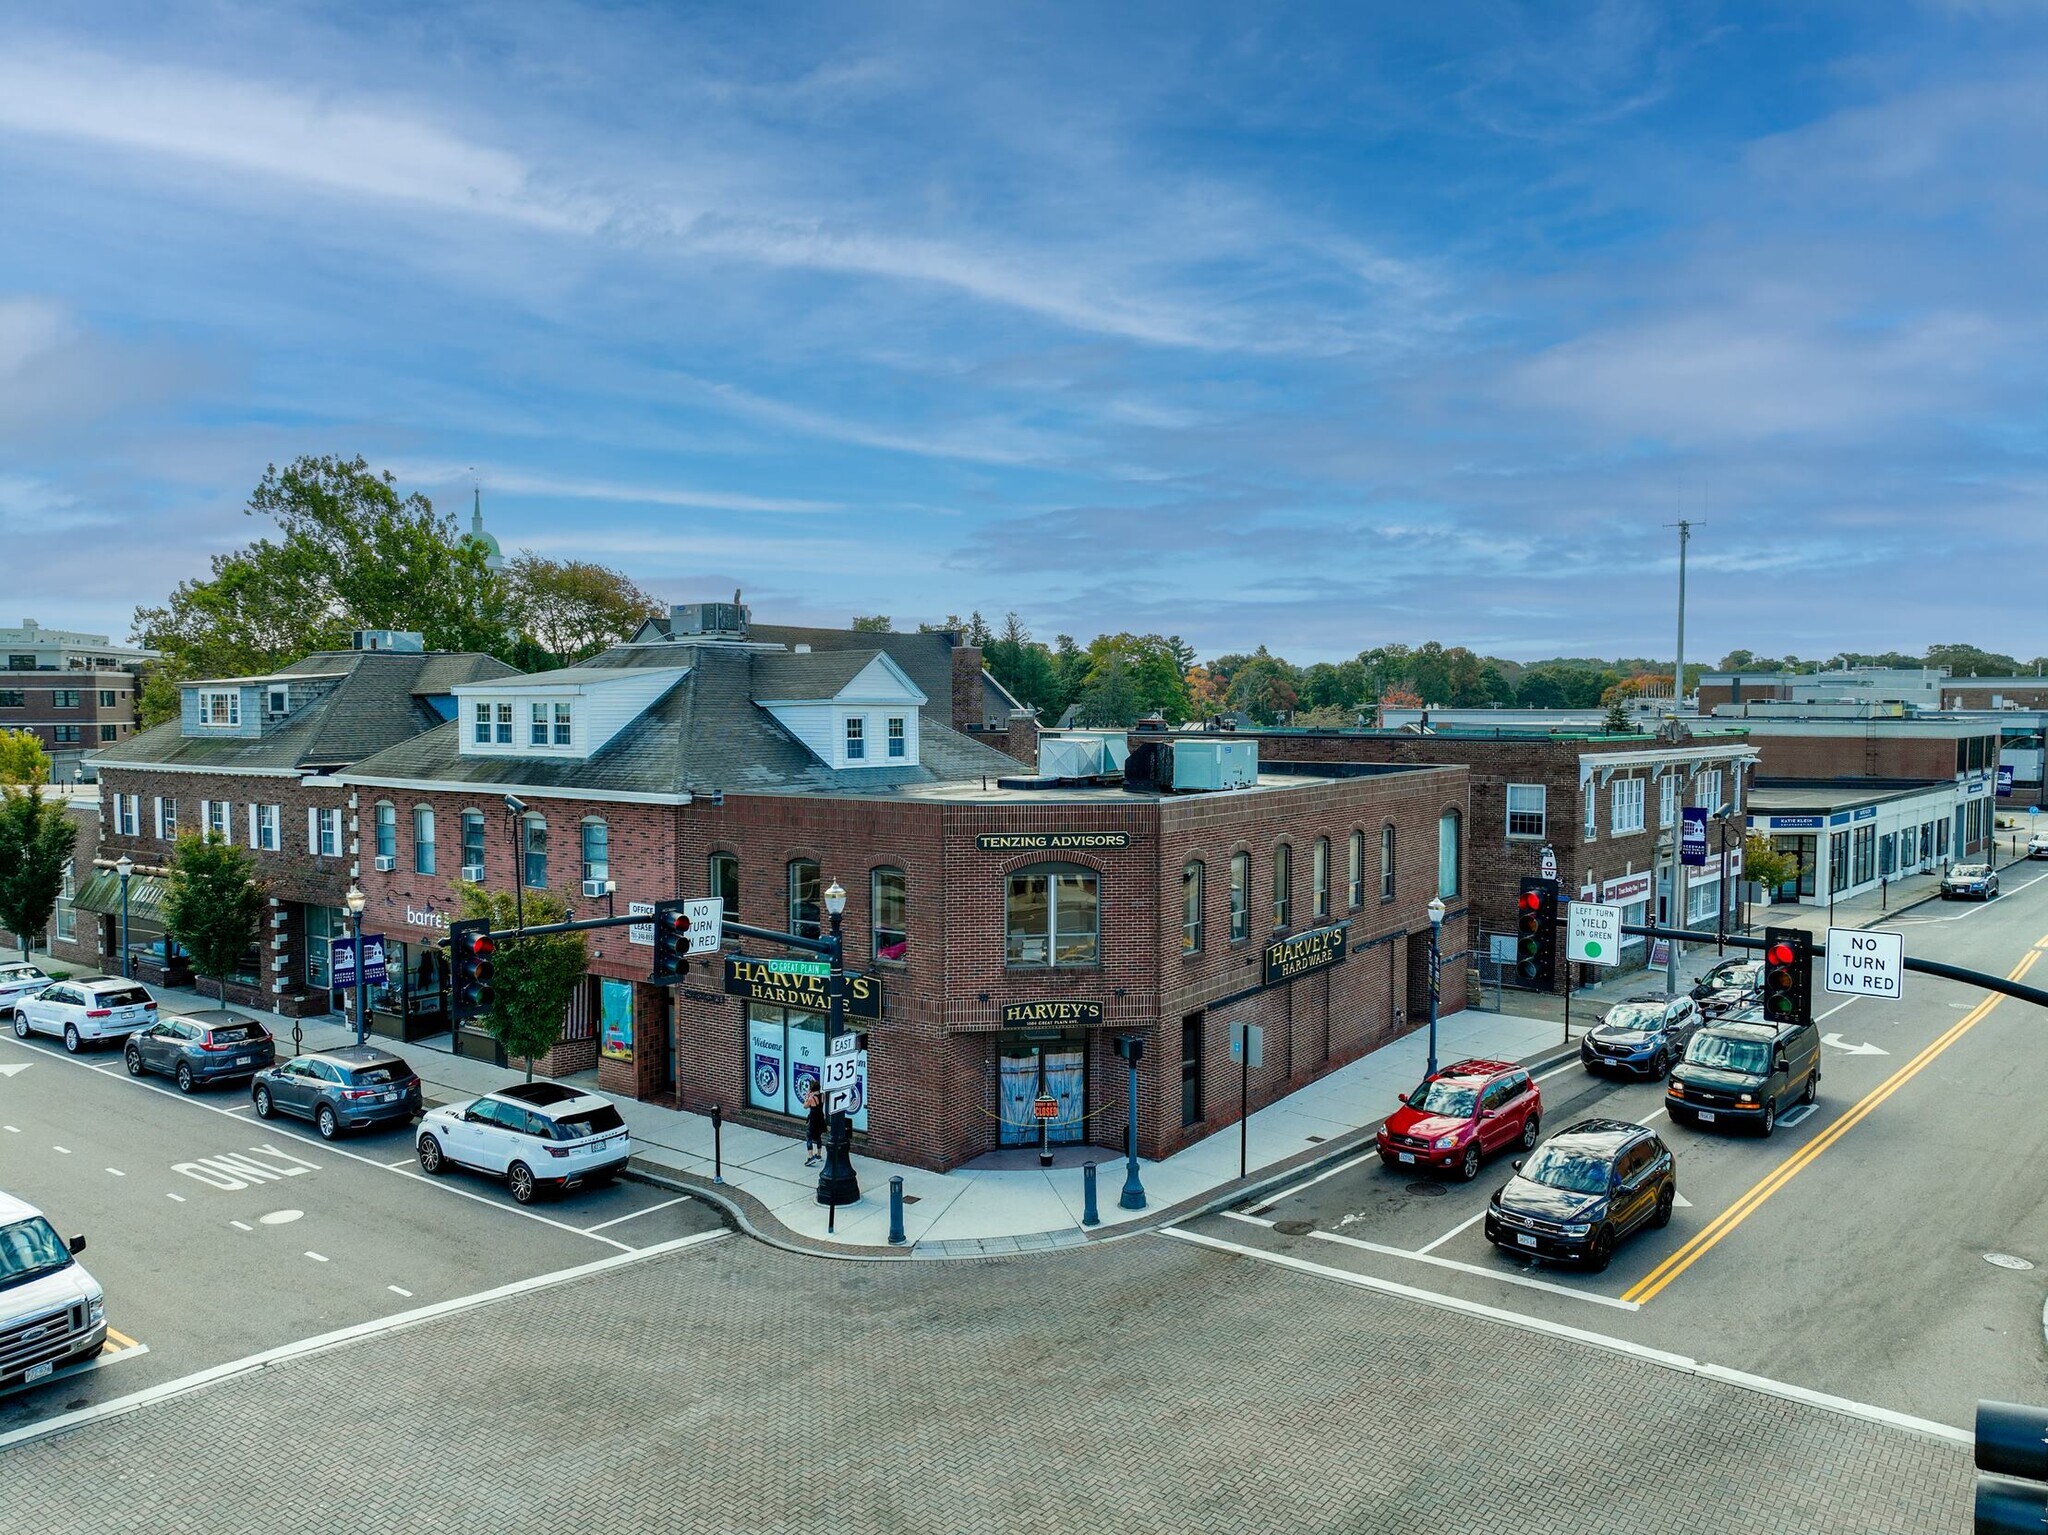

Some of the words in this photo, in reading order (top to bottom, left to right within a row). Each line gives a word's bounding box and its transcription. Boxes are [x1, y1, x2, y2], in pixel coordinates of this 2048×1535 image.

[981, 837, 1047, 847] TENZING
[1050, 835, 1125, 847] ADVISORS
[632, 905, 654, 915] OFFICE
[693, 905, 709, 917] NO
[1575, 907, 1592, 915] LEFT
[1596, 910, 1614, 918] TURN
[634, 922, 652, 932] LEASE
[1581, 917, 1608, 930] YIELD
[698, 935, 716, 948] RED
[1575, 929, 1586, 937] ON
[1589, 931, 1612, 940] GREEN
[1271, 928, 1342, 967] HARVEY'S
[1851, 937, 1877, 951] NO
[779, 962, 798, 973] GREAT
[800, 963, 820, 974] PLAIN
[1282, 949, 1333, 976] HARDWARE
[1843, 954, 1885, 971] TURN
[733, 961, 870, 999] HARVE'S
[1833, 972, 1854, 986] ON
[1863, 975, 1894, 990] RED
[751, 984, 850, 1013] HARDWAE
[1007, 1003, 1100, 1021] HARVEY'S
[752, 1036, 783, 1051] Welcome
[835, 1038, 852, 1052] EAST
[801, 1046, 810, 1057] To
[826, 1059, 855, 1083] 135
[1035, 1106, 1058, 1117] CLOSED
[170, 1144, 323, 1191] ONLY
